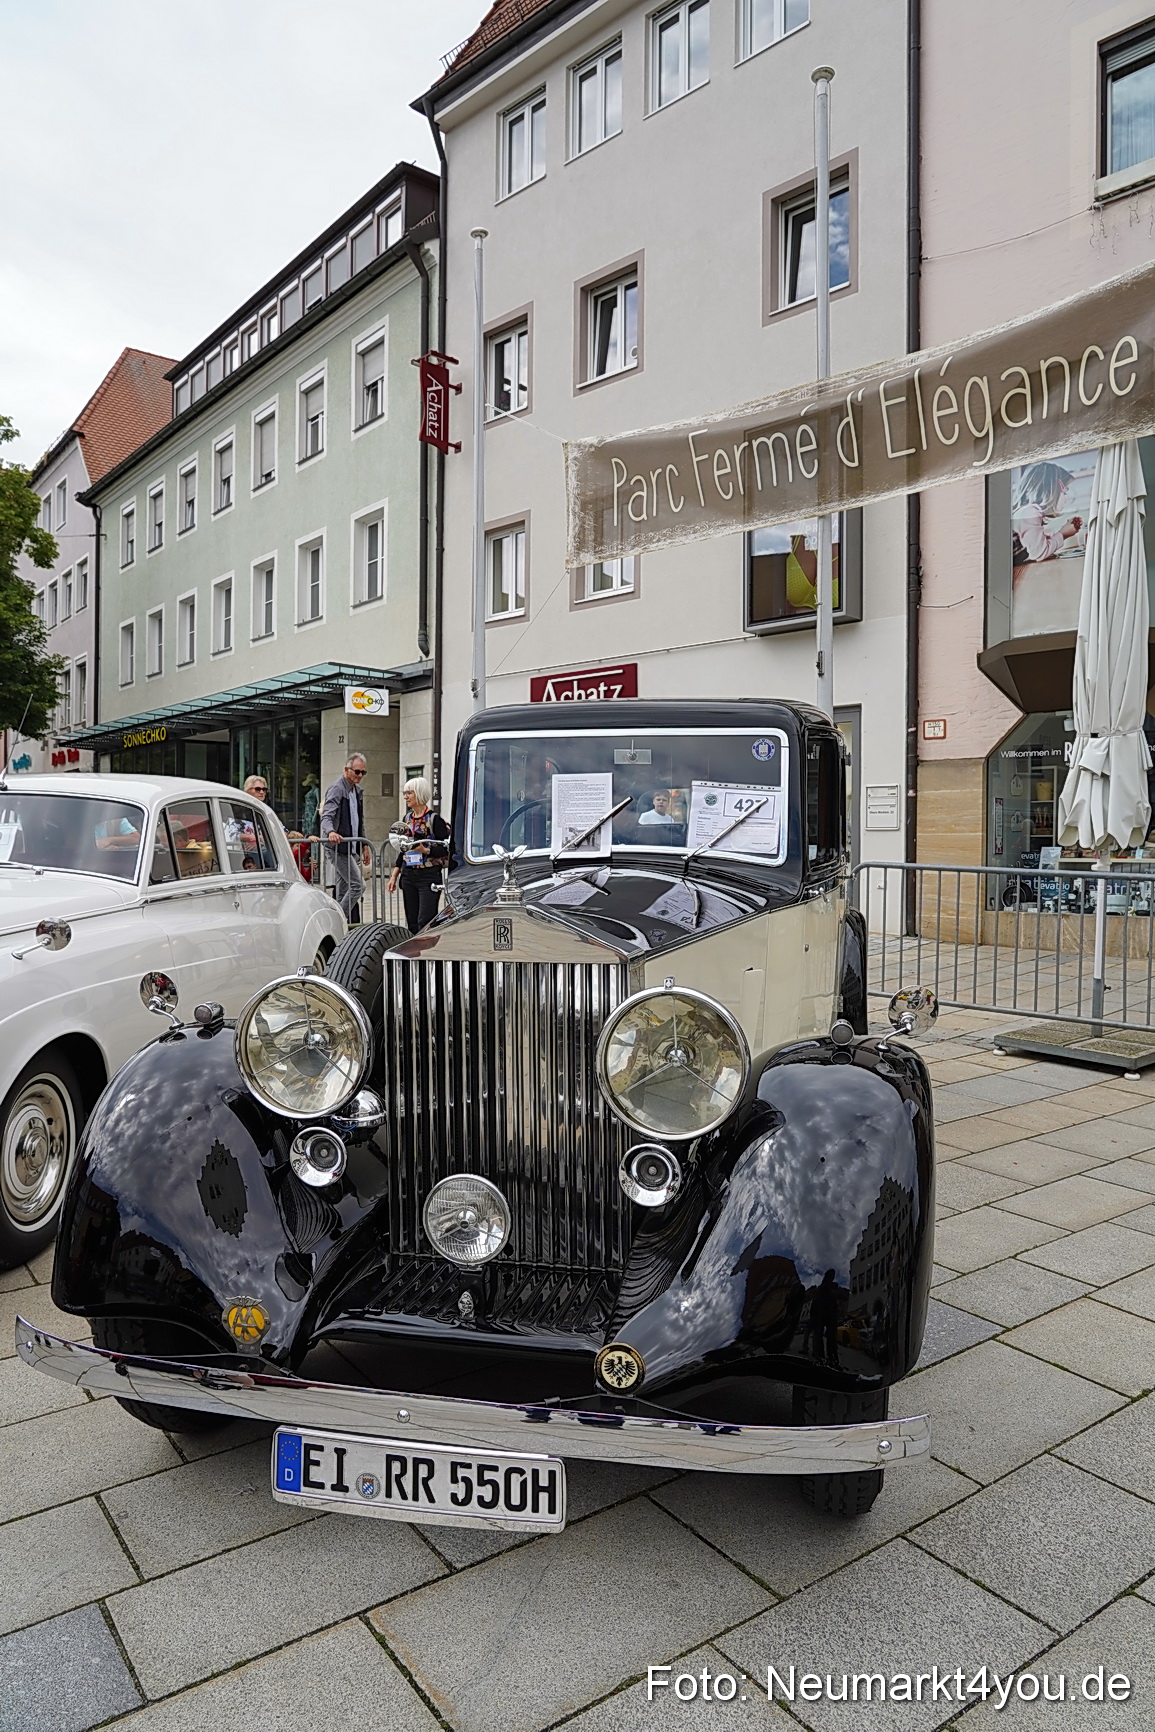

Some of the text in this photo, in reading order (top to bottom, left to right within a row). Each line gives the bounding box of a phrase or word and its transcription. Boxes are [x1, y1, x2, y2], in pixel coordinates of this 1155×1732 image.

[426, 373, 444, 439] Achatz
[611, 457, 685, 527] Parc
[687, 402, 820, 507] Fermé
[123, 726, 167, 748] SONNECHKO
[1000, 750, 1050, 758] Willkommen
[284, 1468, 294, 1481] D
[302, 1442, 349, 1493] EI
[385, 1453, 436, 1504] RR
[450, 1460, 557, 1515] 550H
